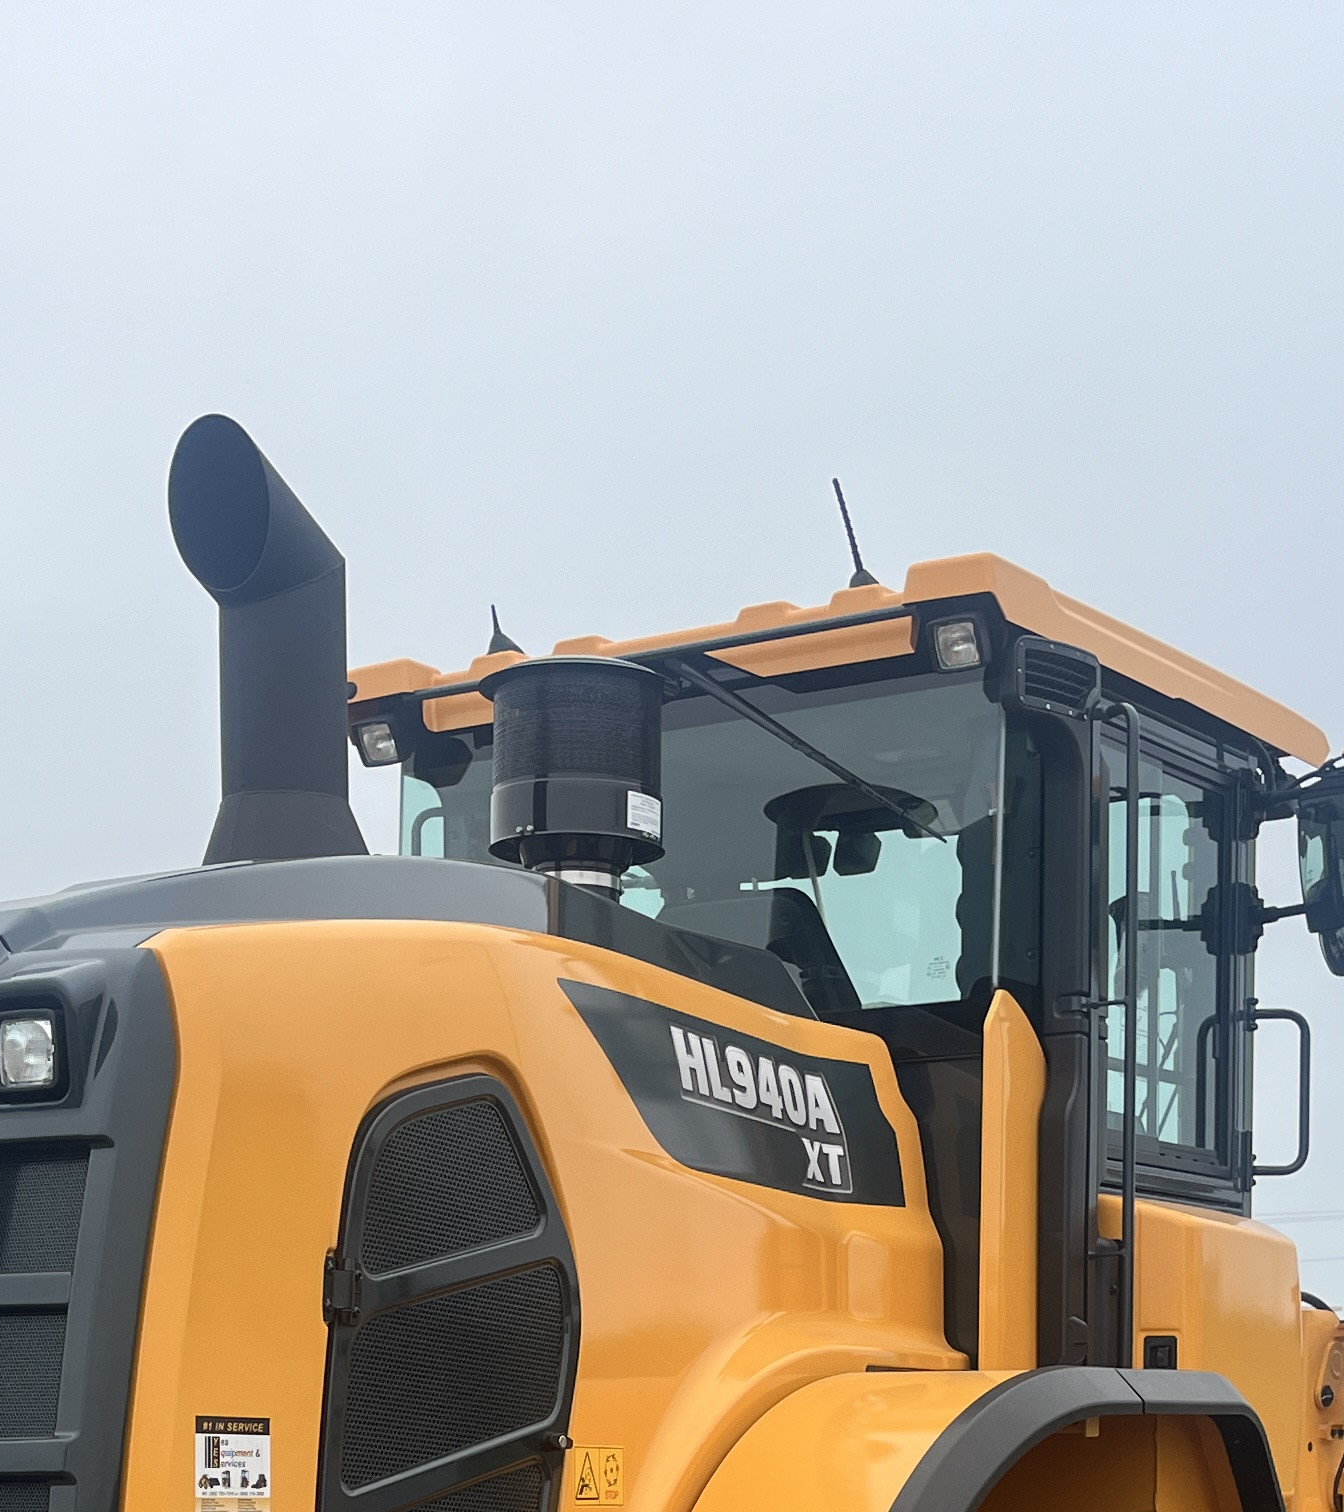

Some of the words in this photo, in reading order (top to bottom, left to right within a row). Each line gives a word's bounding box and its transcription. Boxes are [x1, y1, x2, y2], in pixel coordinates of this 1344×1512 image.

[670, 1025, 841, 1134] HL940A
[801, 1137, 844, 1185] XT
[215, 1422, 225, 1431] IN
[226, 1422, 265, 1433] SERVICE
